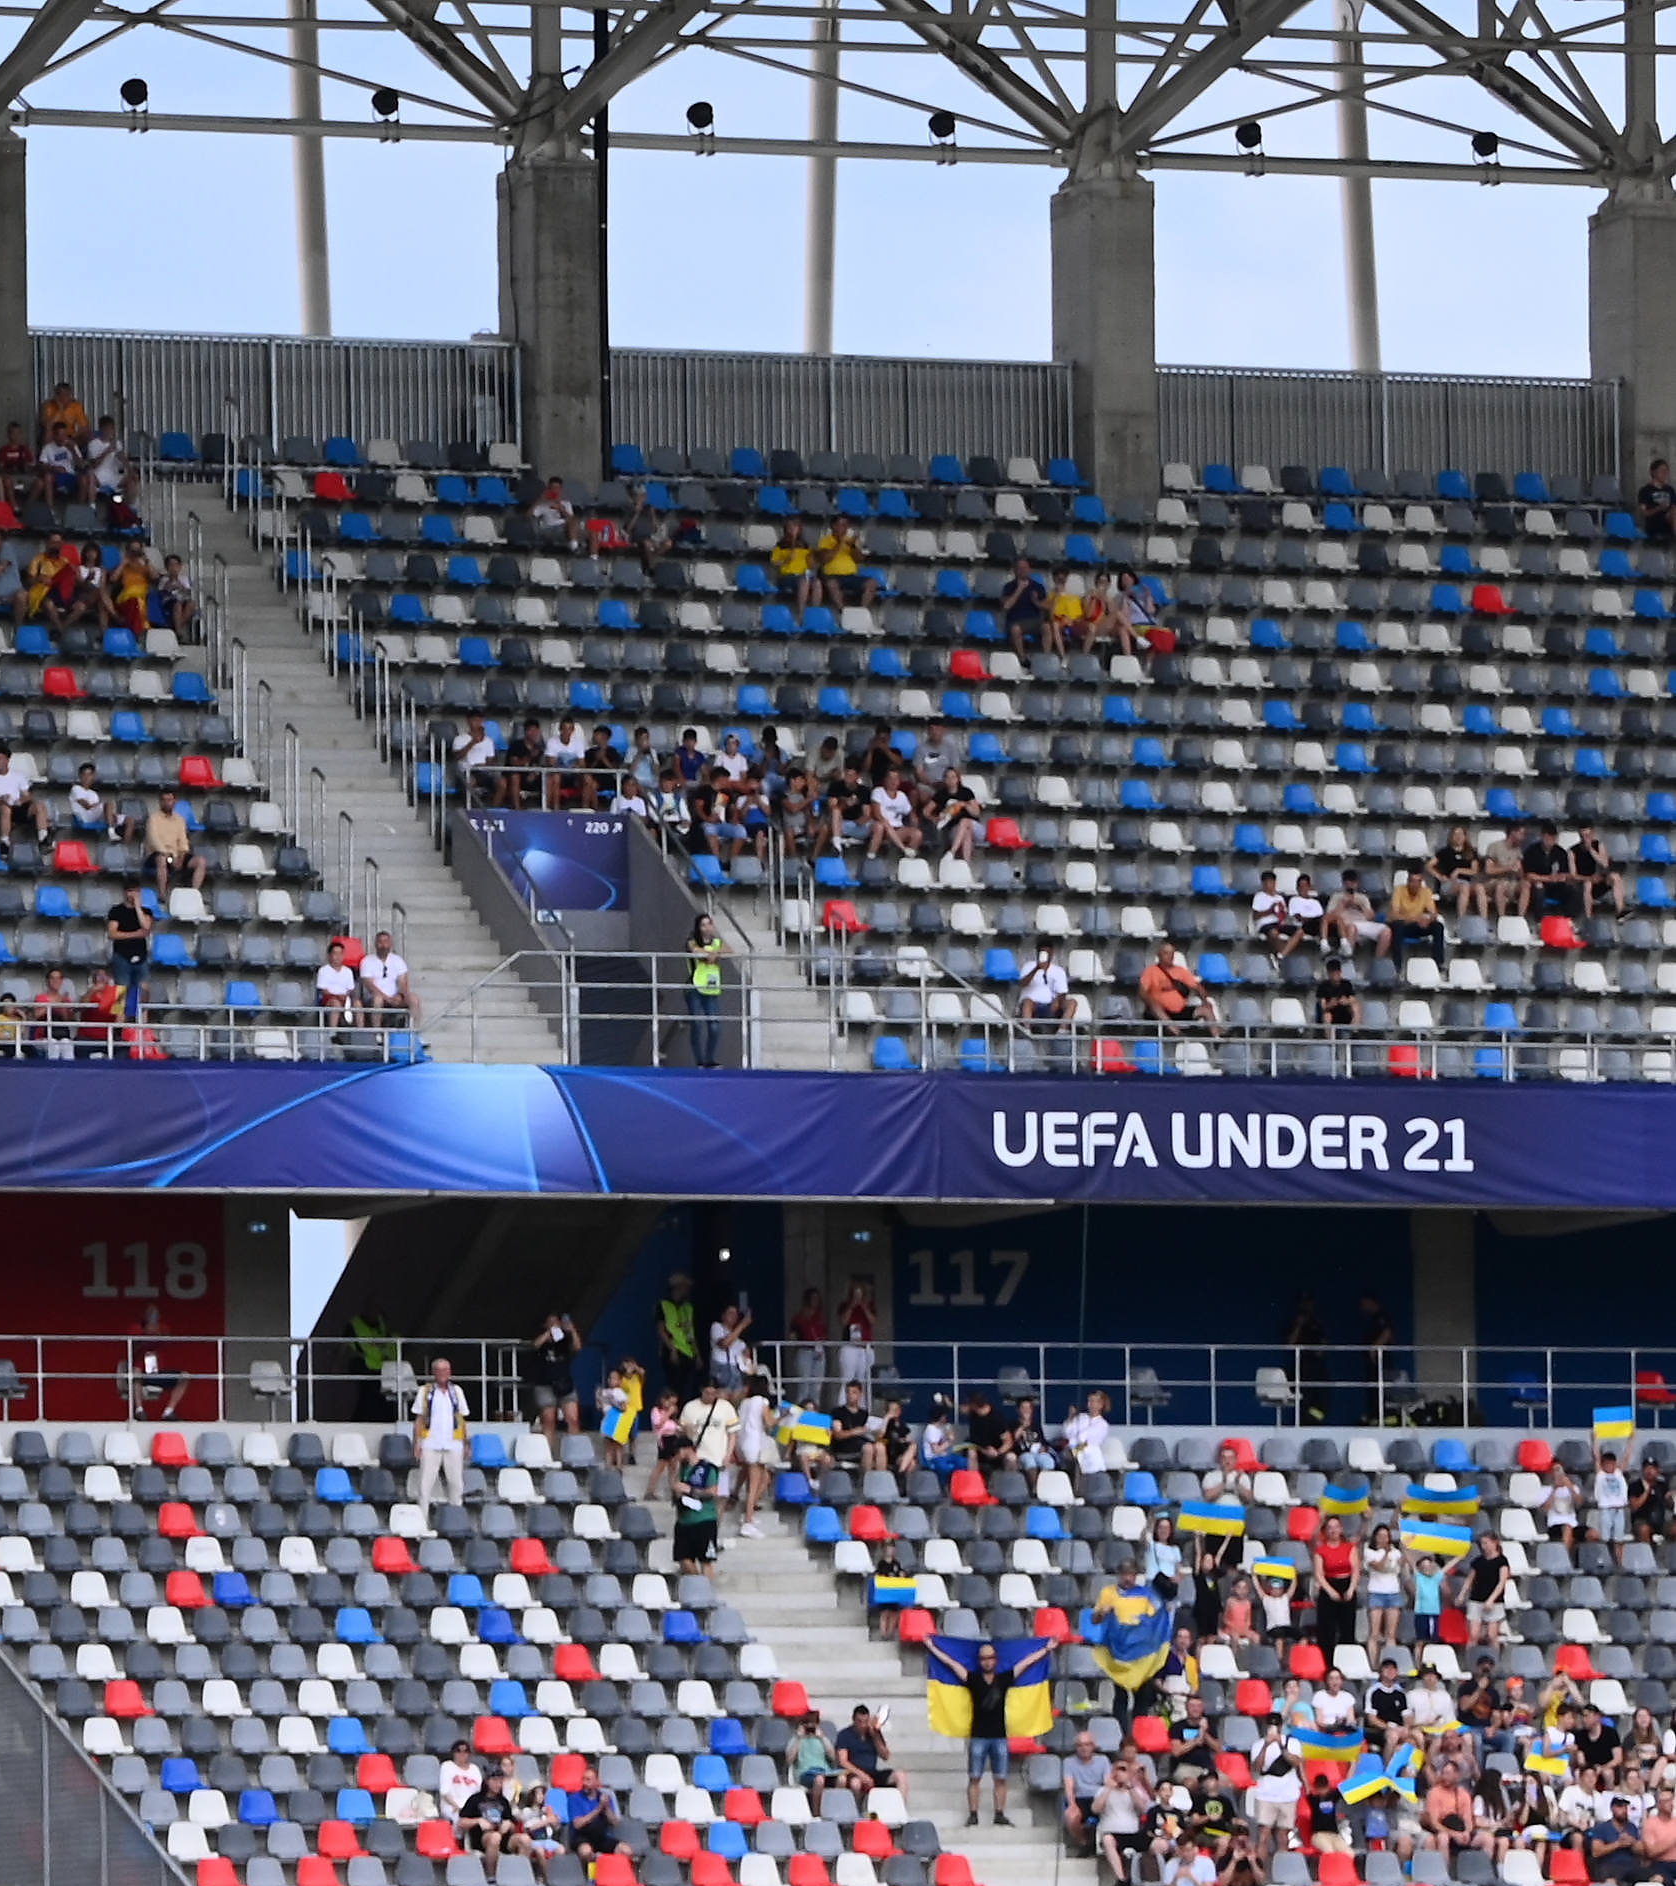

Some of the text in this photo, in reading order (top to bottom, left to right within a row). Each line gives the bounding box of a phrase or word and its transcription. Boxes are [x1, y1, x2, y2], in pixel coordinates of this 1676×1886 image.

[585, 821, 609, 834] 220
[992, 1111, 1474, 1172] UEFA UNDER 21
[81, 1242, 208, 1299] 118
[906, 1249, 1032, 1307] 117
